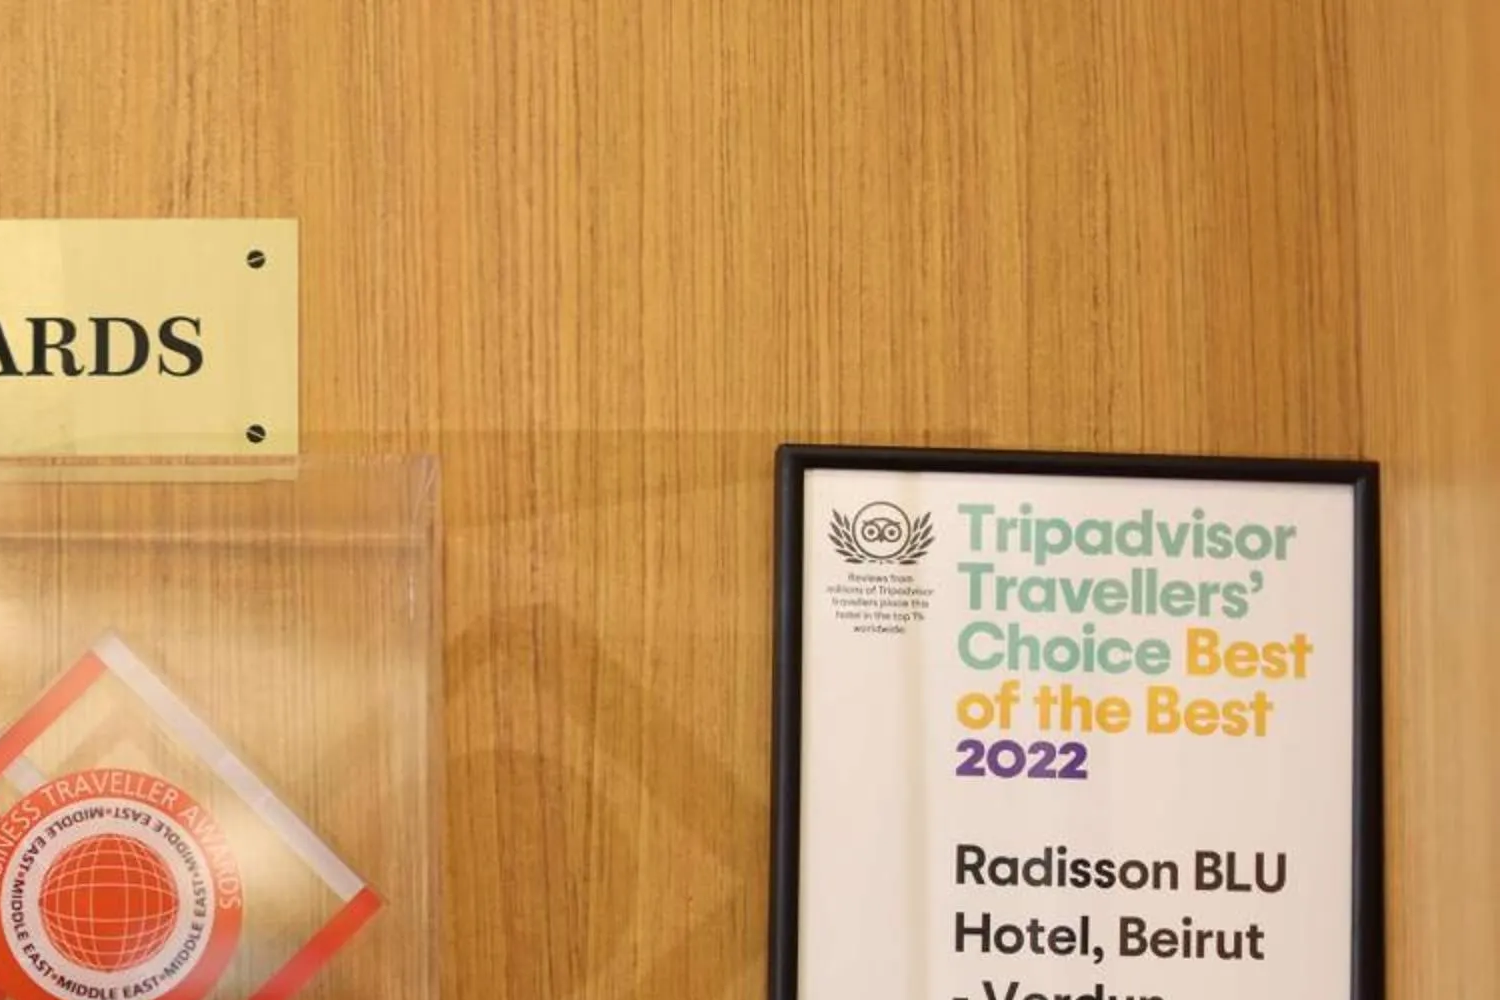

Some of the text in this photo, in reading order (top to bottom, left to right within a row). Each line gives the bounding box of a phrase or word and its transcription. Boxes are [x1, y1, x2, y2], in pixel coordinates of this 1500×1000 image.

[957, 503, 1297, 565] Tripadvisor
[848, 573, 914, 583] Reviews from
[866, 585, 876, 595] of
[878, 586, 934, 597] Tripadvisor
[957, 563, 1263, 619] Travellers’
[893, 612, 910, 622] top
[957, 621, 1314, 679] Choice Best
[956, 680, 1274, 737] of the Best
[955, 739, 1088, 780] 2022
[41, 771, 180, 809] TRAVELLER
[179, 802, 242, 910] AWARDS
[955, 844, 1287, 893] Radisson BLU
[11, 806, 206, 1000] MIDDLE EAST MIDDLE EAST MIDDLE EAST MIDDLE EAST MIDDLE EAST
[954, 912, 1265, 964] Hotel, Beirut
